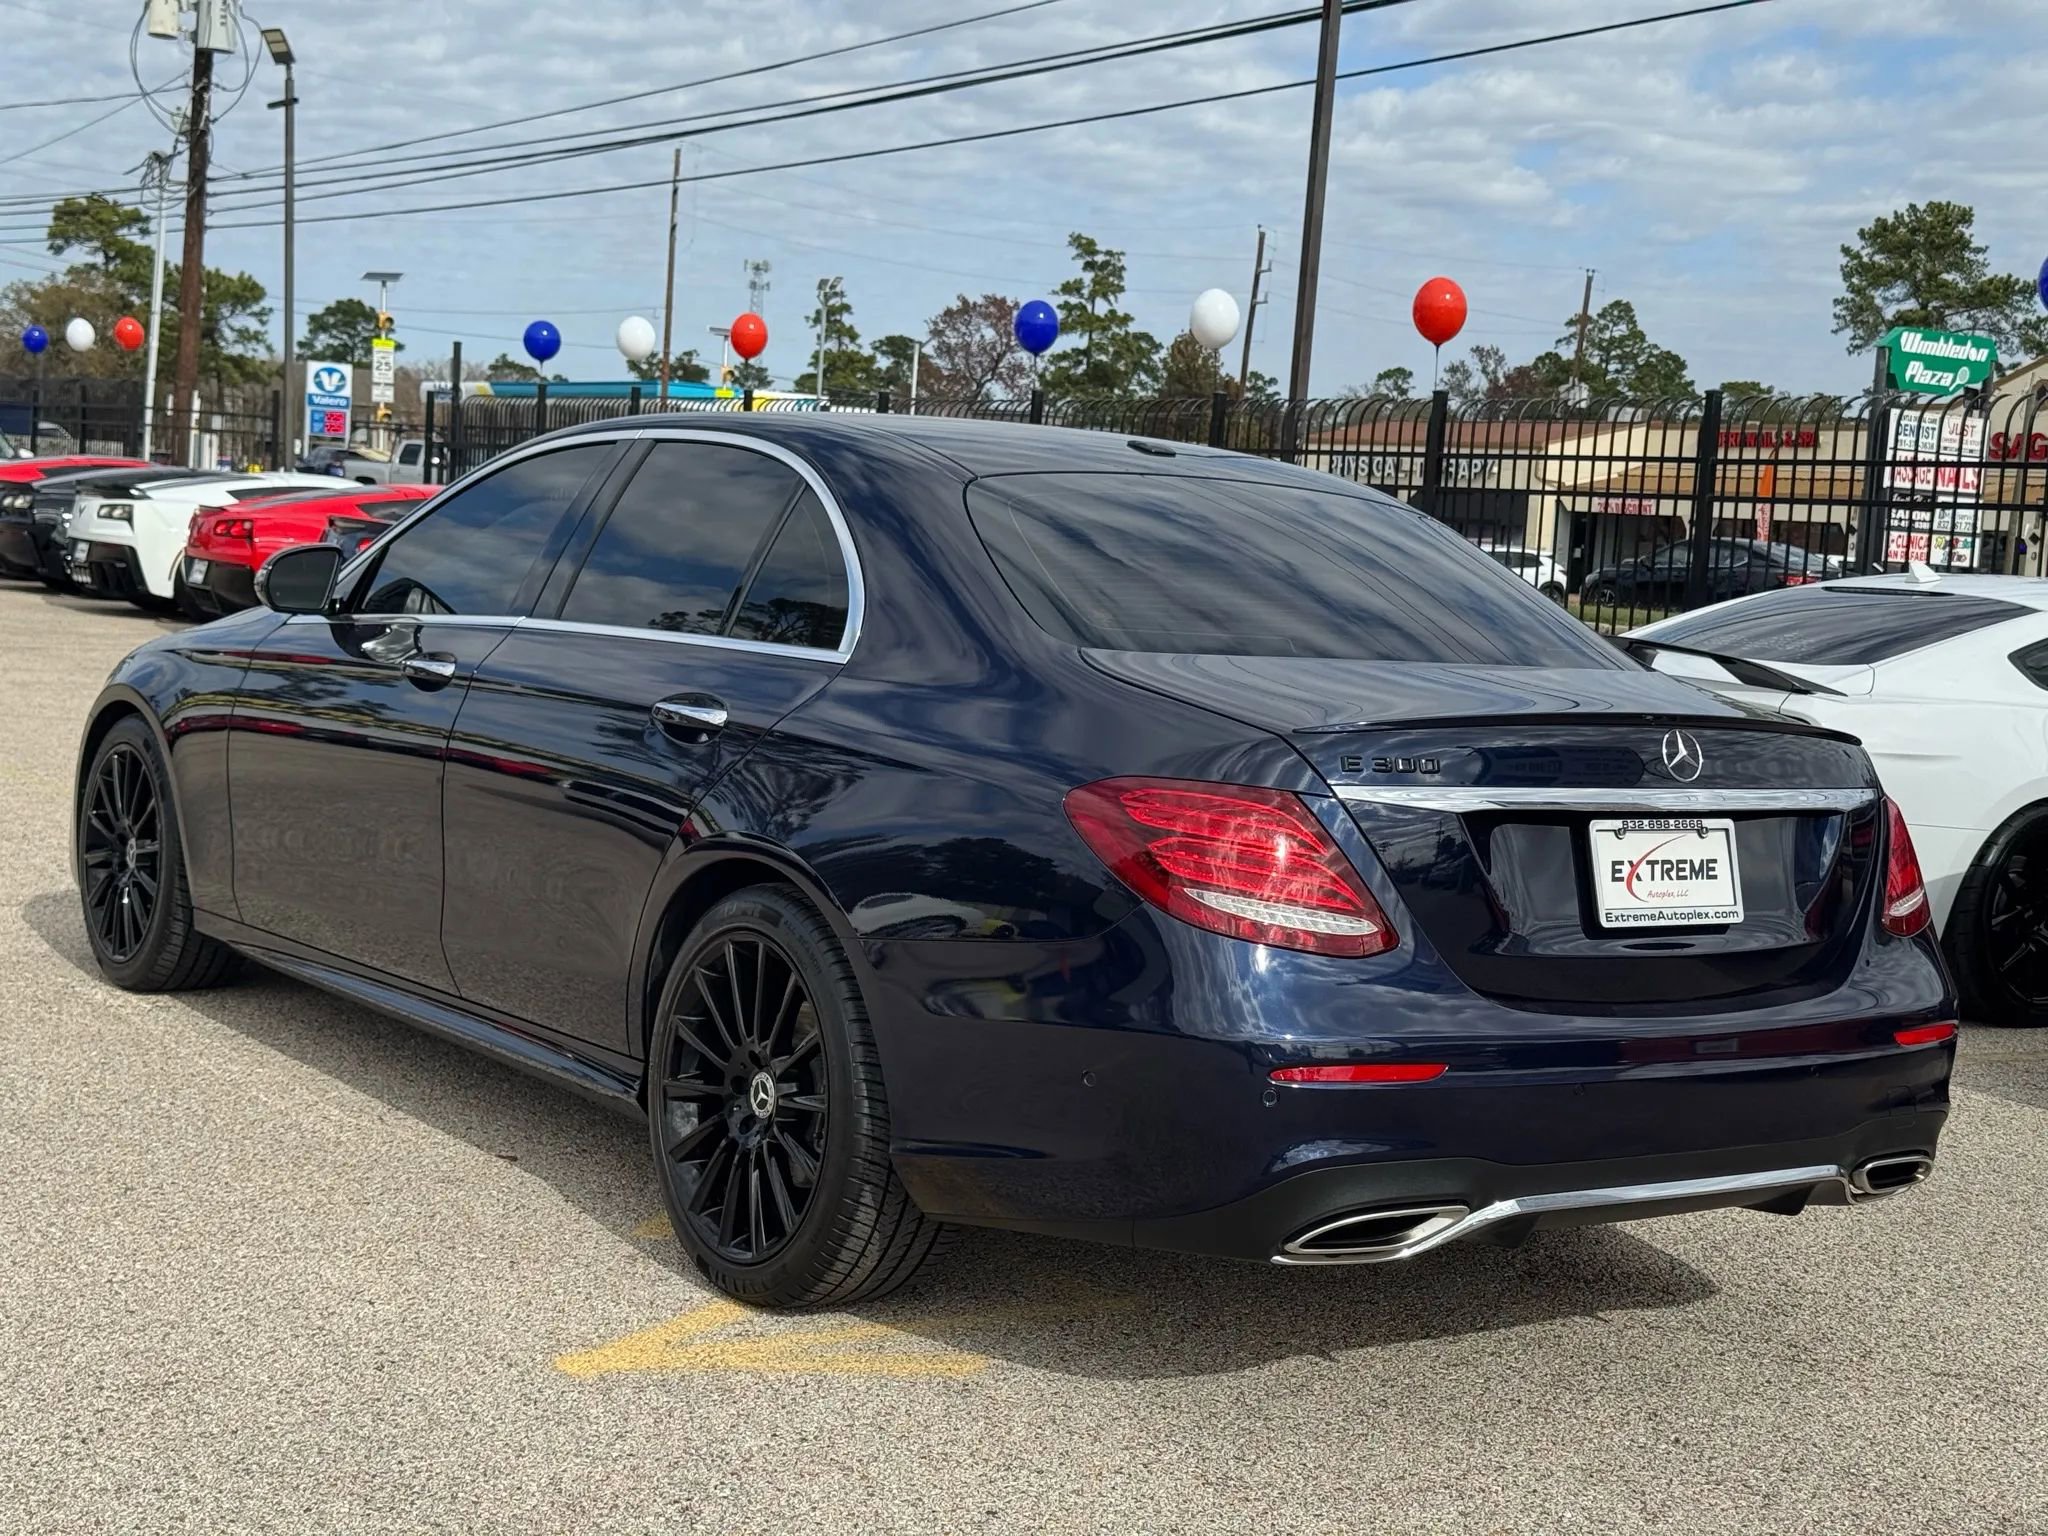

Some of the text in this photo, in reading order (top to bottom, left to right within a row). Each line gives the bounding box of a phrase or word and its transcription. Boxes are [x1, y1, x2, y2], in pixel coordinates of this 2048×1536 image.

[1900, 331, 1989, 362] Wimbledon
[375, 361, 392, 371] 25
[1905, 361, 1955, 387] Plaza
[312, 395, 348, 406] Valero
[1340, 756, 1441, 775] E 300
[1610, 857, 1718, 883] EXTREME
[1676, 889, 1689, 898] LLC
[1604, 909, 1740, 923] ExtremeAutoplex.com
